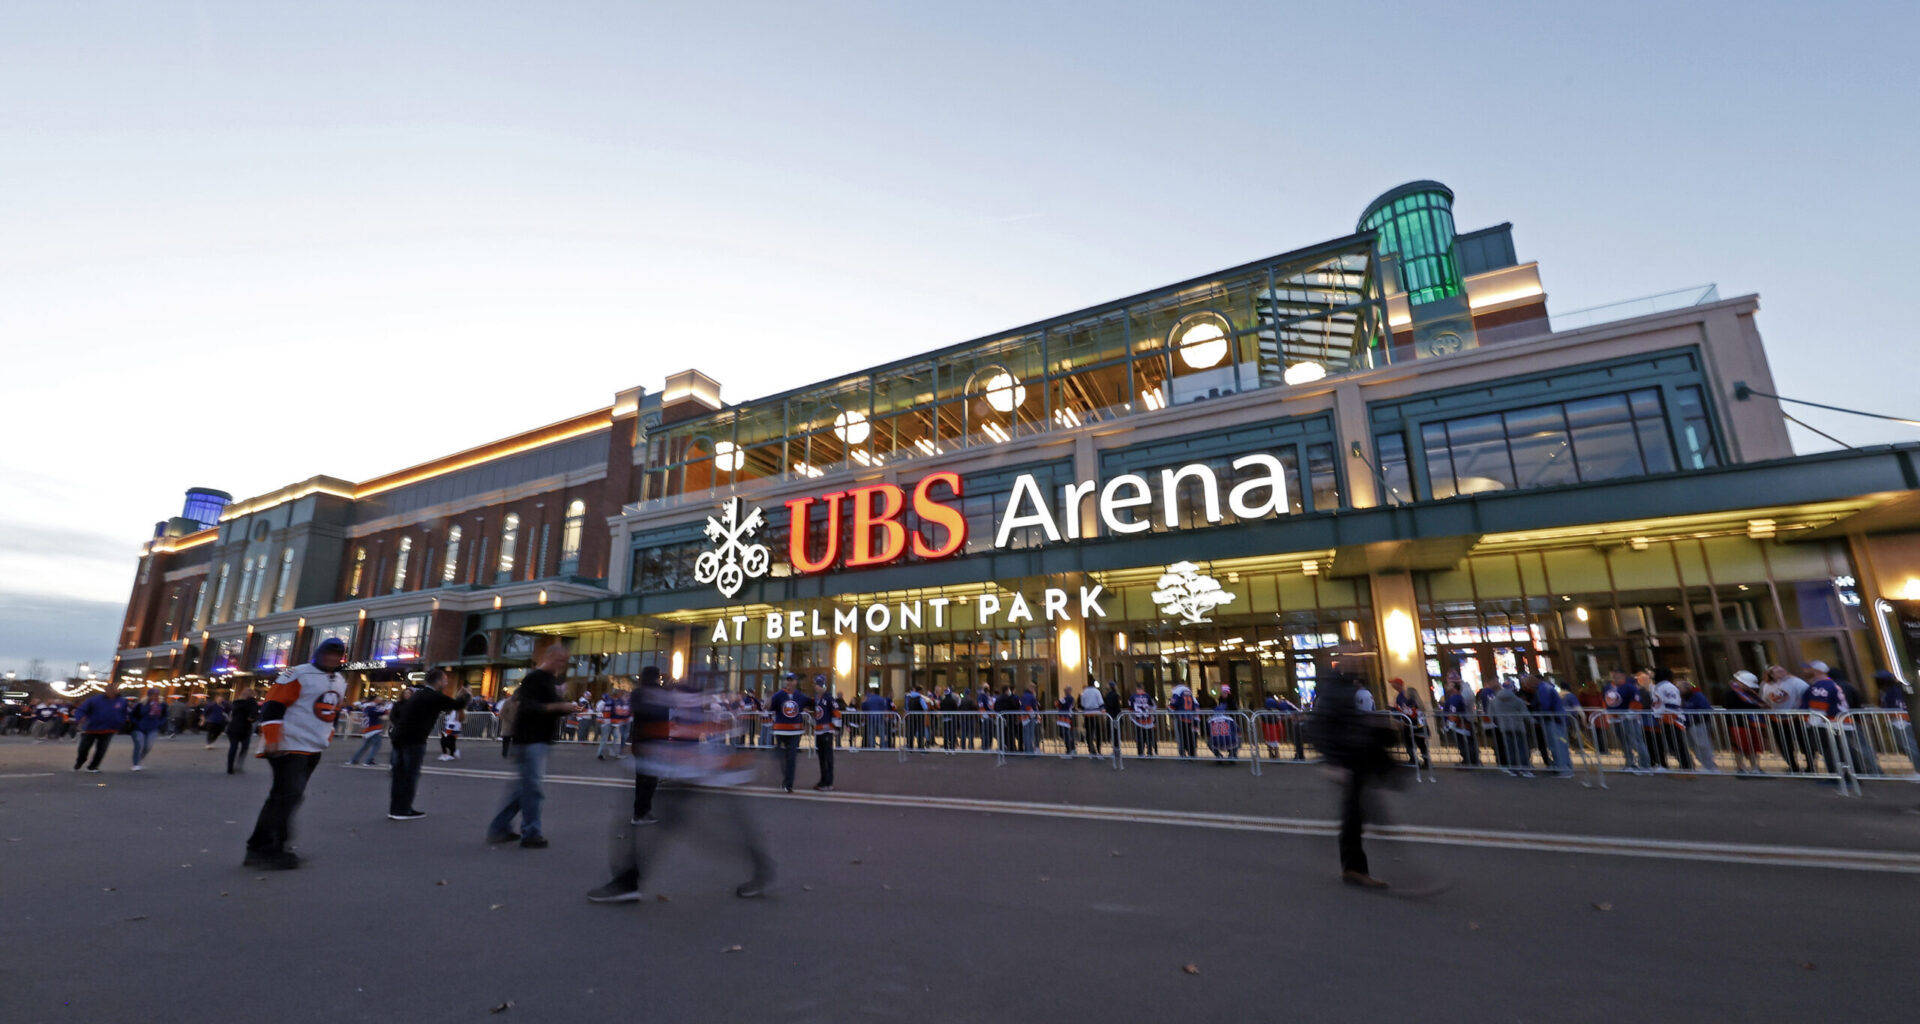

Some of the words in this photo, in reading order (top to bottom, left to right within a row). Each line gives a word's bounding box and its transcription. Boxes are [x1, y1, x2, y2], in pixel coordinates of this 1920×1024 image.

[785, 471, 968, 574] UBS
[994, 453, 1290, 549] Arena
[712, 615, 748, 643] AT
[766, 597, 950, 640] BELMONT
[979, 585, 1107, 625] PARK
